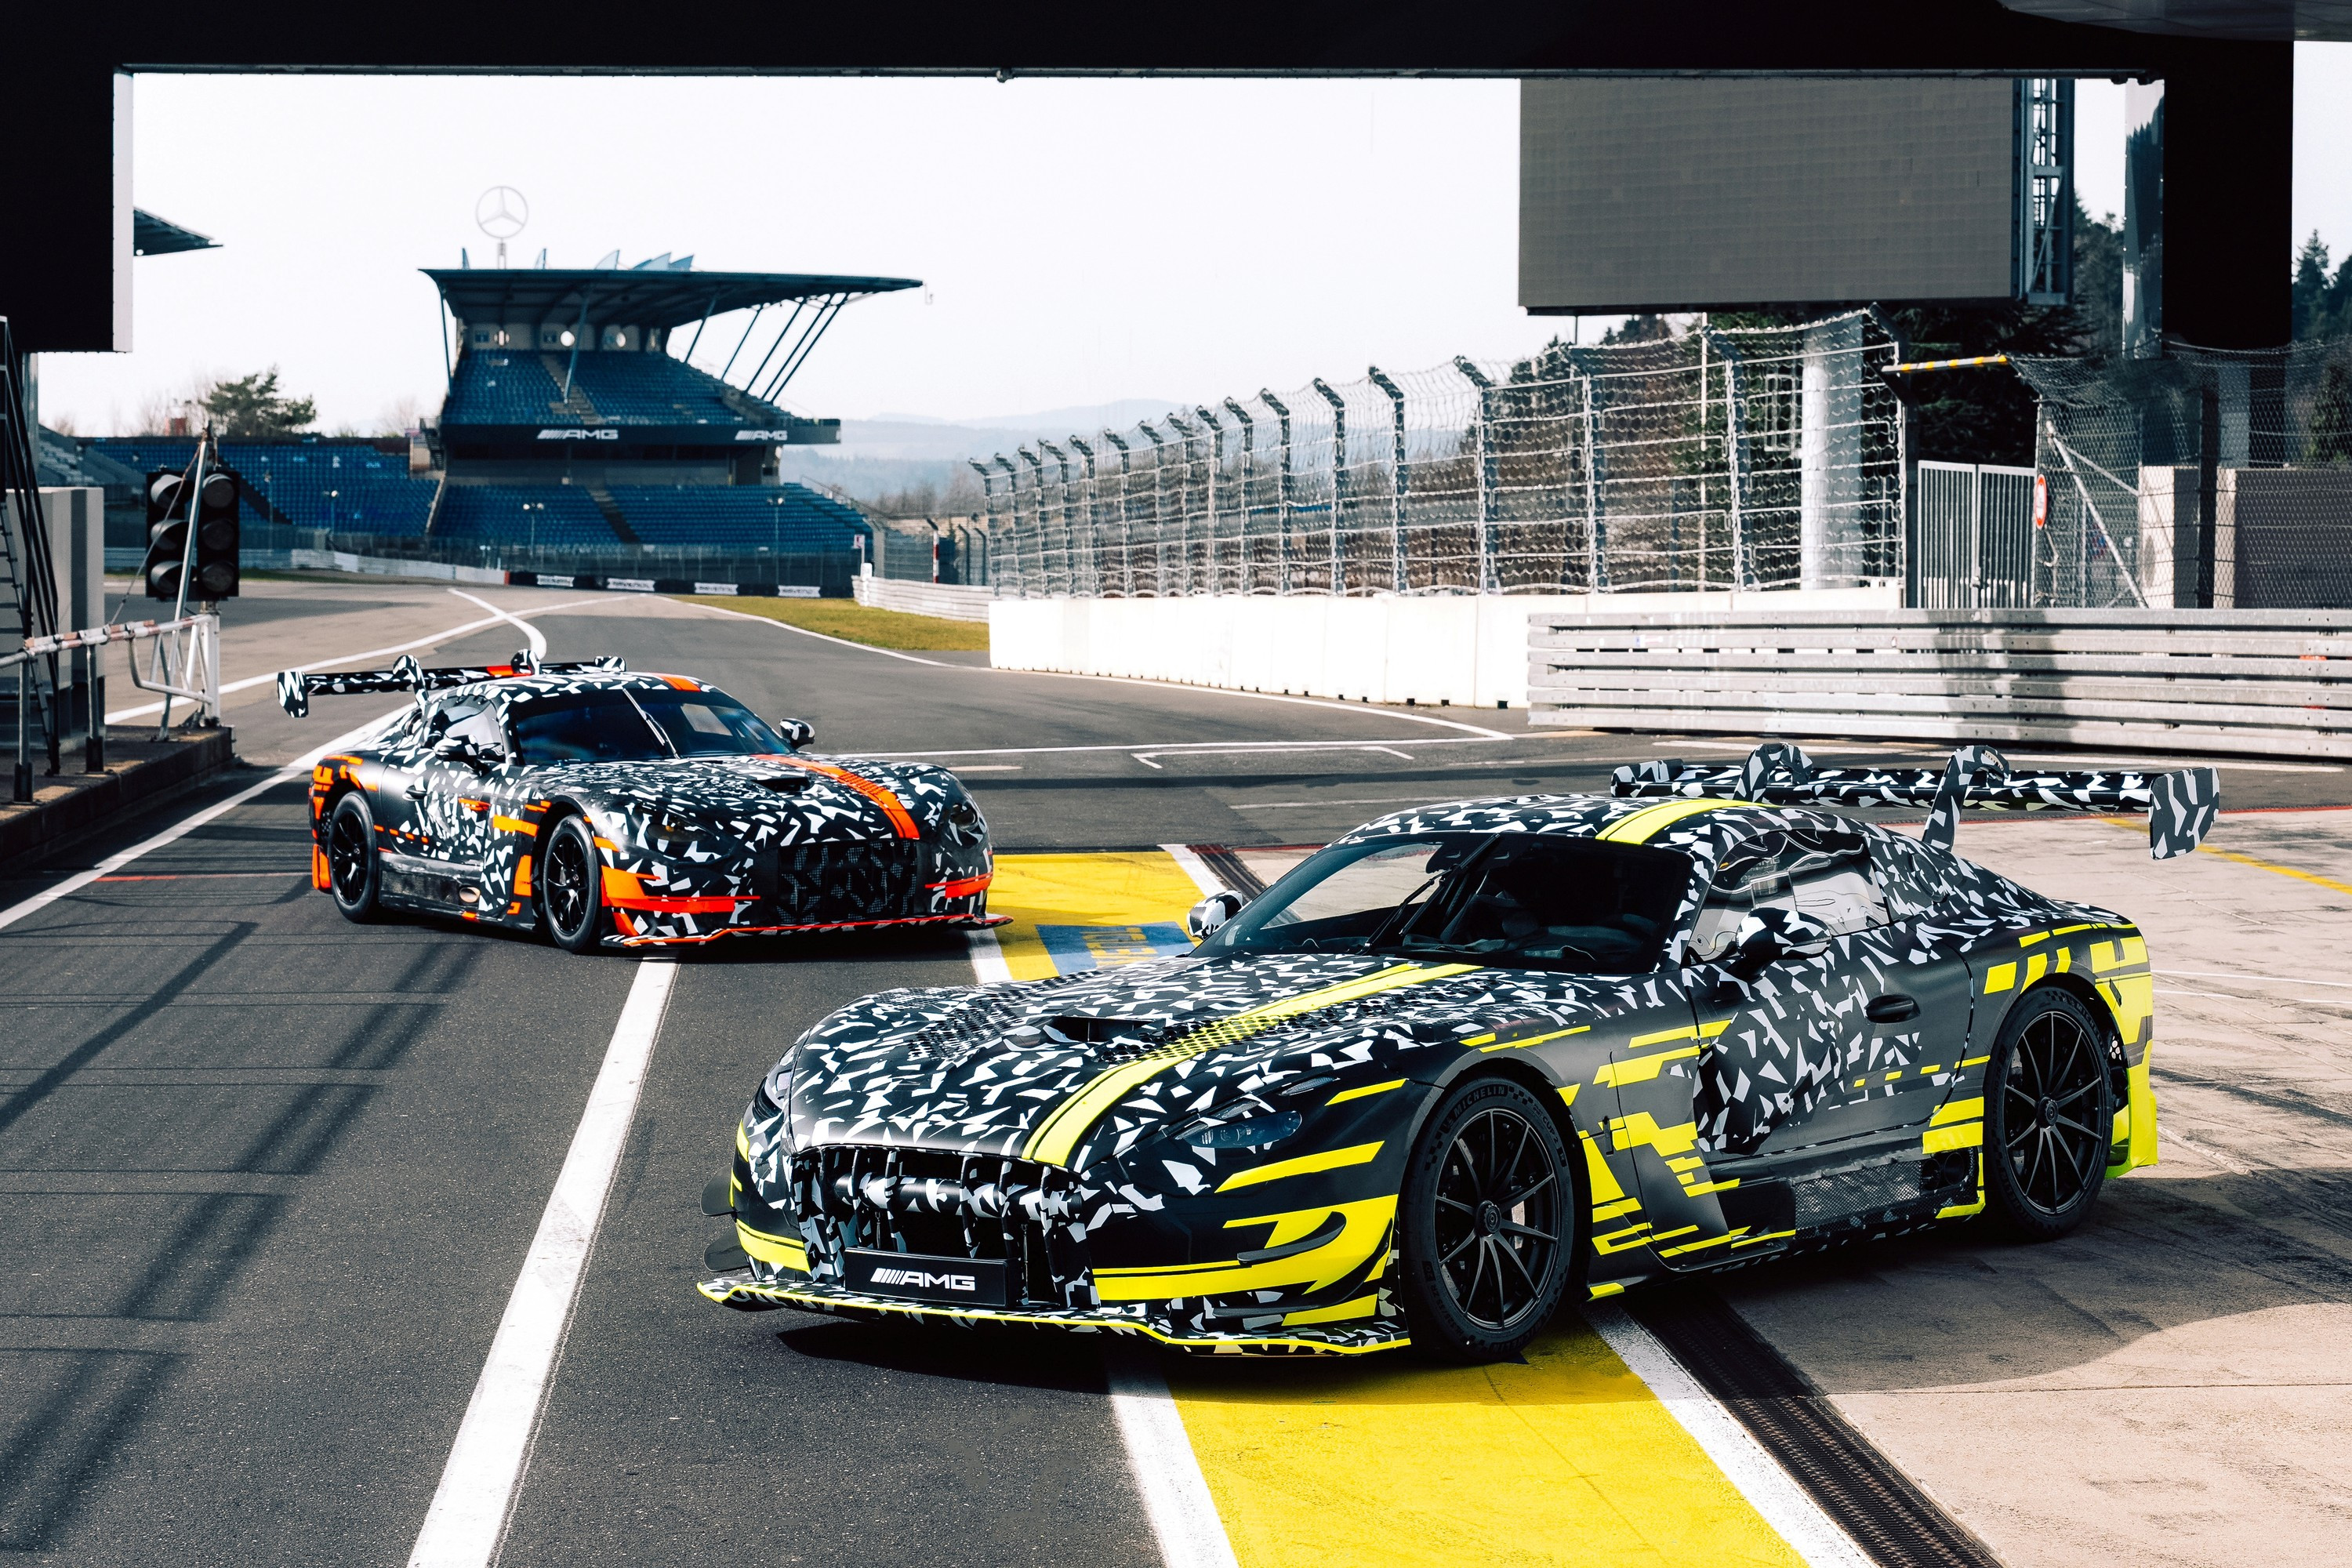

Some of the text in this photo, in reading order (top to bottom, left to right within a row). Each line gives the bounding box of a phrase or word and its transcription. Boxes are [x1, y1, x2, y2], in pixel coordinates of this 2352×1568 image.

[562, 429, 619, 440] AMG
[750, 430, 788, 441] AMG
[1079, 927, 1159, 965] VENOL
[1452, 1085, 1504, 1119] MICHELIN
[1541, 1113, 1555, 1137] CUP
[1552, 1134, 1559, 1145] 2
[898, 1270, 975, 1291] AMG
